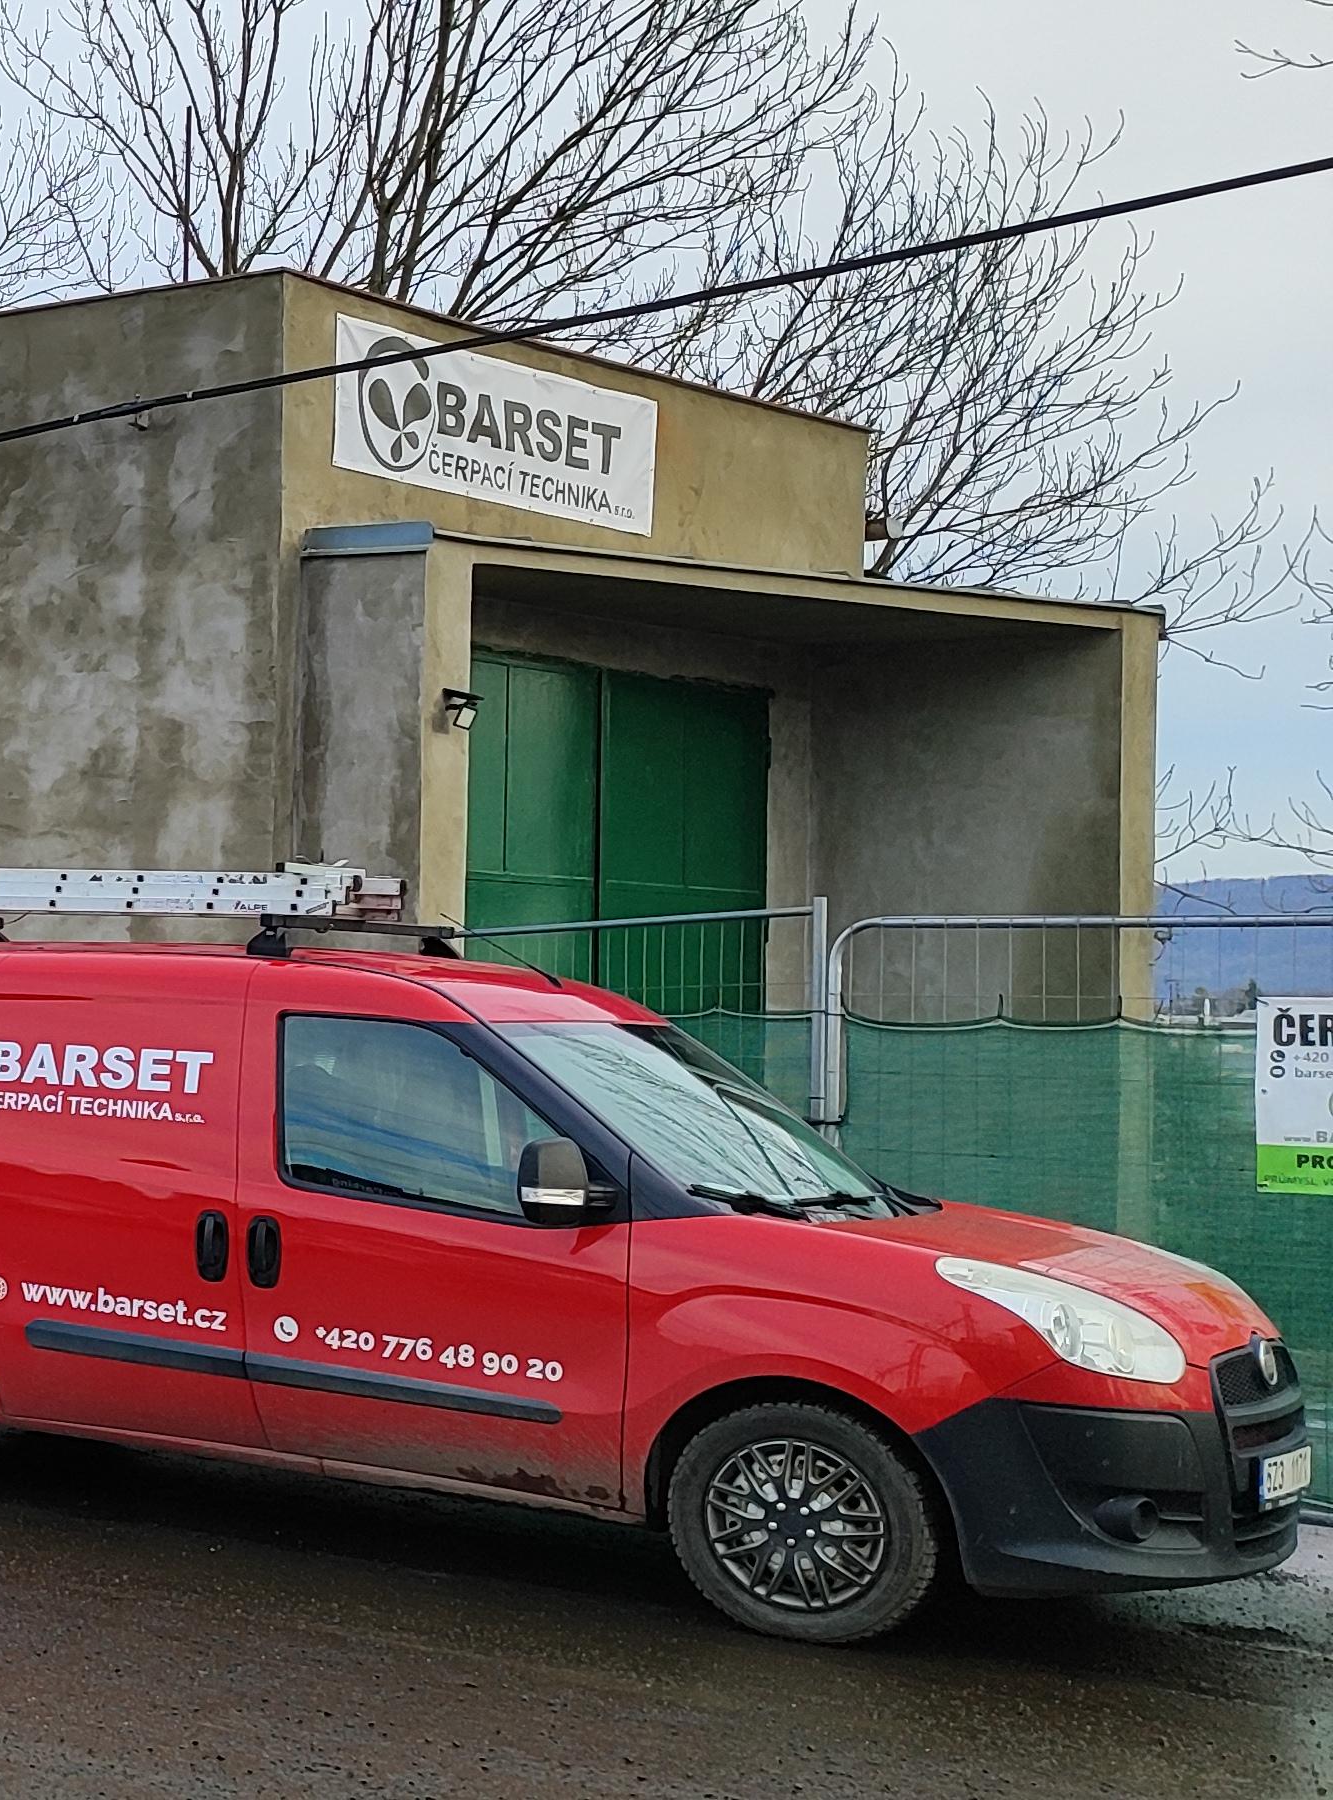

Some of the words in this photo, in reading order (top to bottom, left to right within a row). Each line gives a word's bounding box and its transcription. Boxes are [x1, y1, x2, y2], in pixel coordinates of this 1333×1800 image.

[436, 381, 621, 475] BARSET
[428, 442, 513, 491] ČERPACÍ
[518, 470, 612, 514] TECHNIKA
[1293, 1051, 1330, 1063] +420
[67, 1096, 173, 1121] TECHNIKA
[20, 1282, 228, 1332] www.barset.cz
[314, 1326, 375, 1351] +420
[381, 1335, 433, 1361] 776
[438, 1344, 475, 1368] 48
[482, 1352, 519, 1376] 90
[525, 1358, 564, 1382] 20
